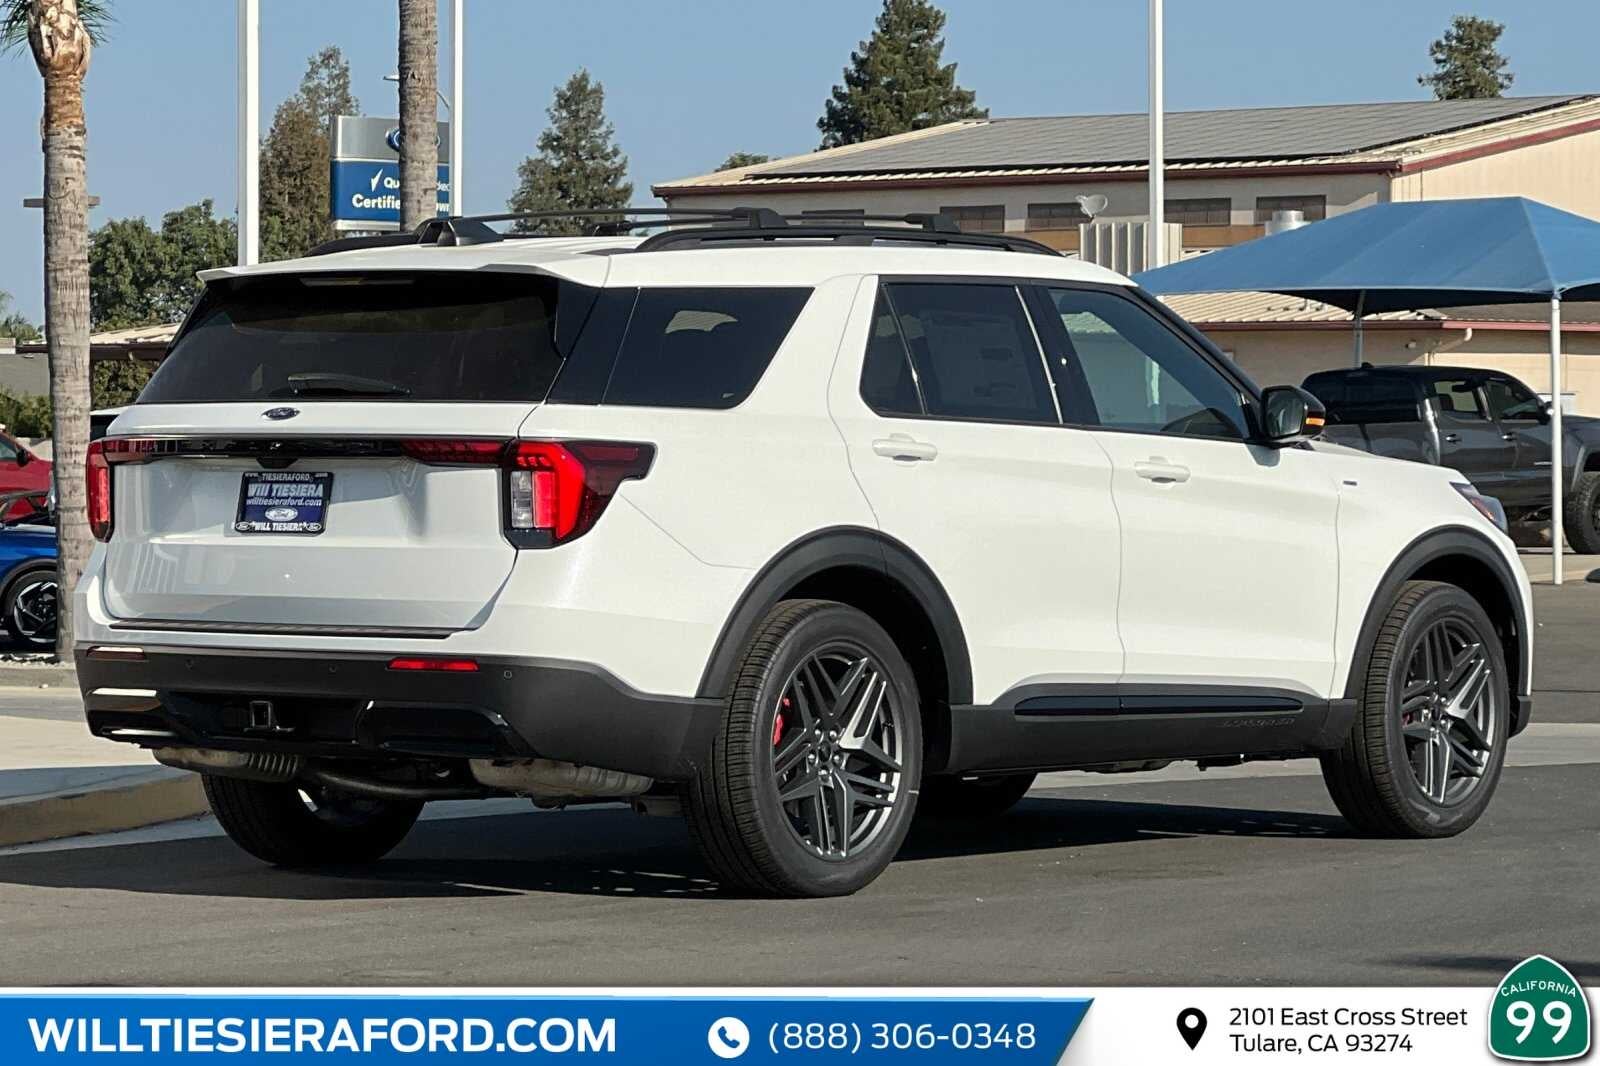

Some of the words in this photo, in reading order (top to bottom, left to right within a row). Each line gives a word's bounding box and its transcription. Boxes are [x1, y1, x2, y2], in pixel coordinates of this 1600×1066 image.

[352, 193, 400, 210] Certifie
[271, 483, 323, 497] TIESIERA
[246, 496, 322, 506] willtiesieraford.com
